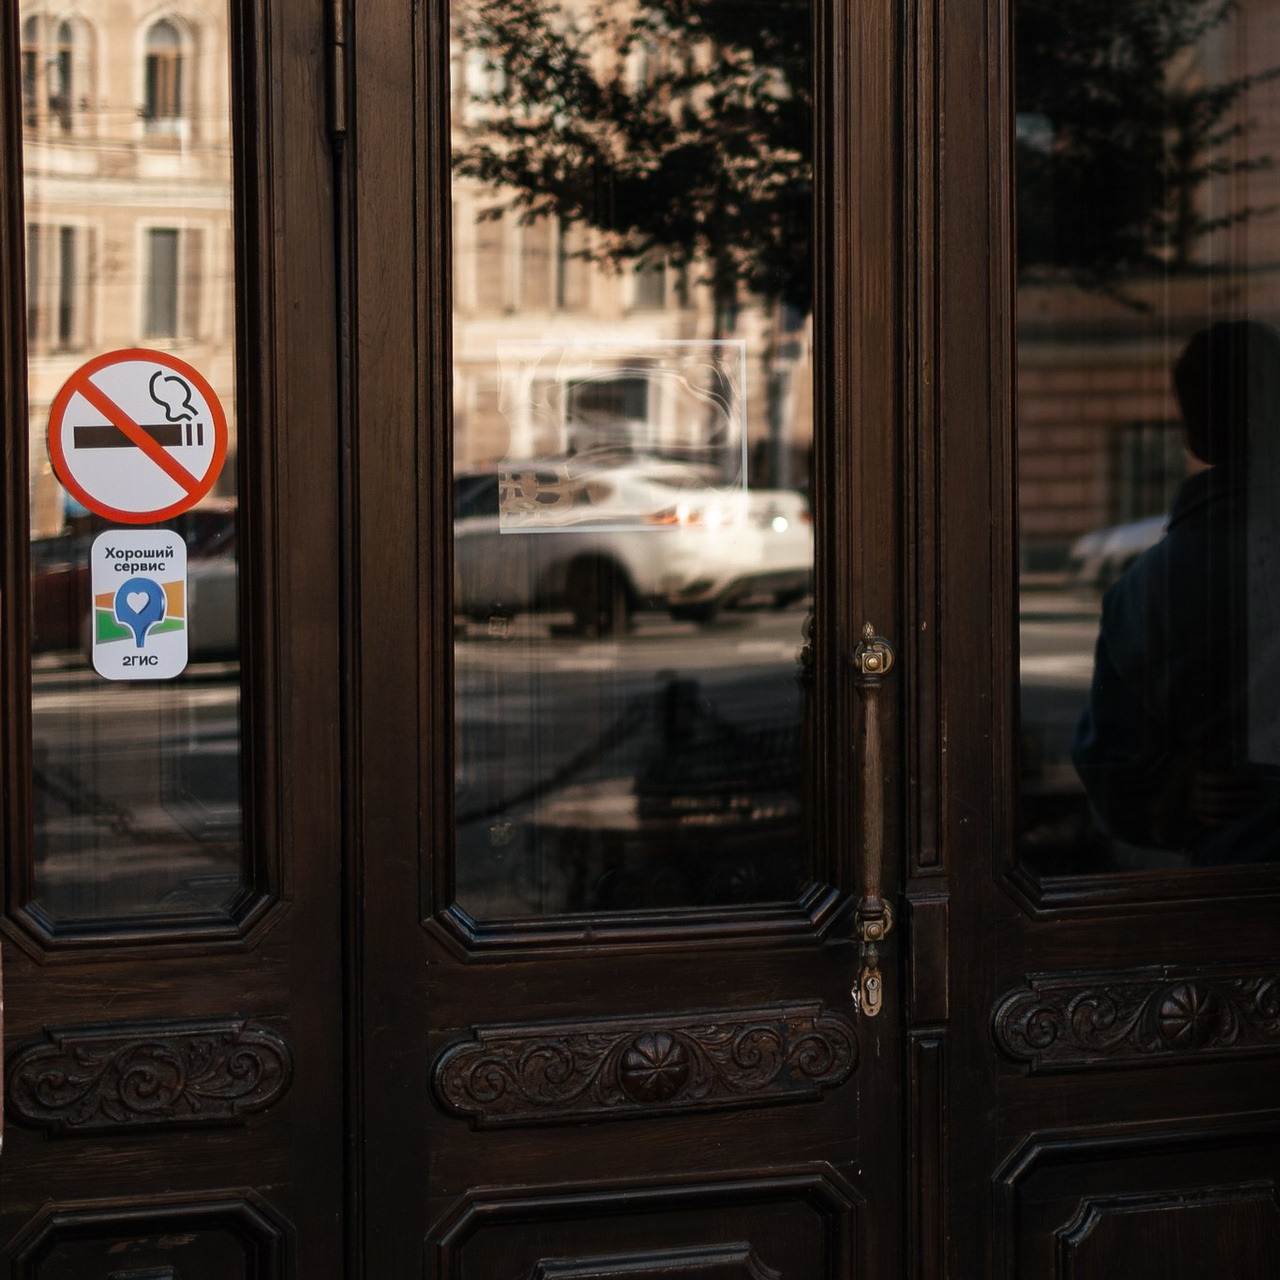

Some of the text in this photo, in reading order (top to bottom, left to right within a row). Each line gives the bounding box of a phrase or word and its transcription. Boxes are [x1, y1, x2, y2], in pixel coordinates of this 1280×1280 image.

[105, 545, 174, 560] Хороший
[114, 561, 166, 575] сервис
[122, 655, 159, 667] 2ГИС
